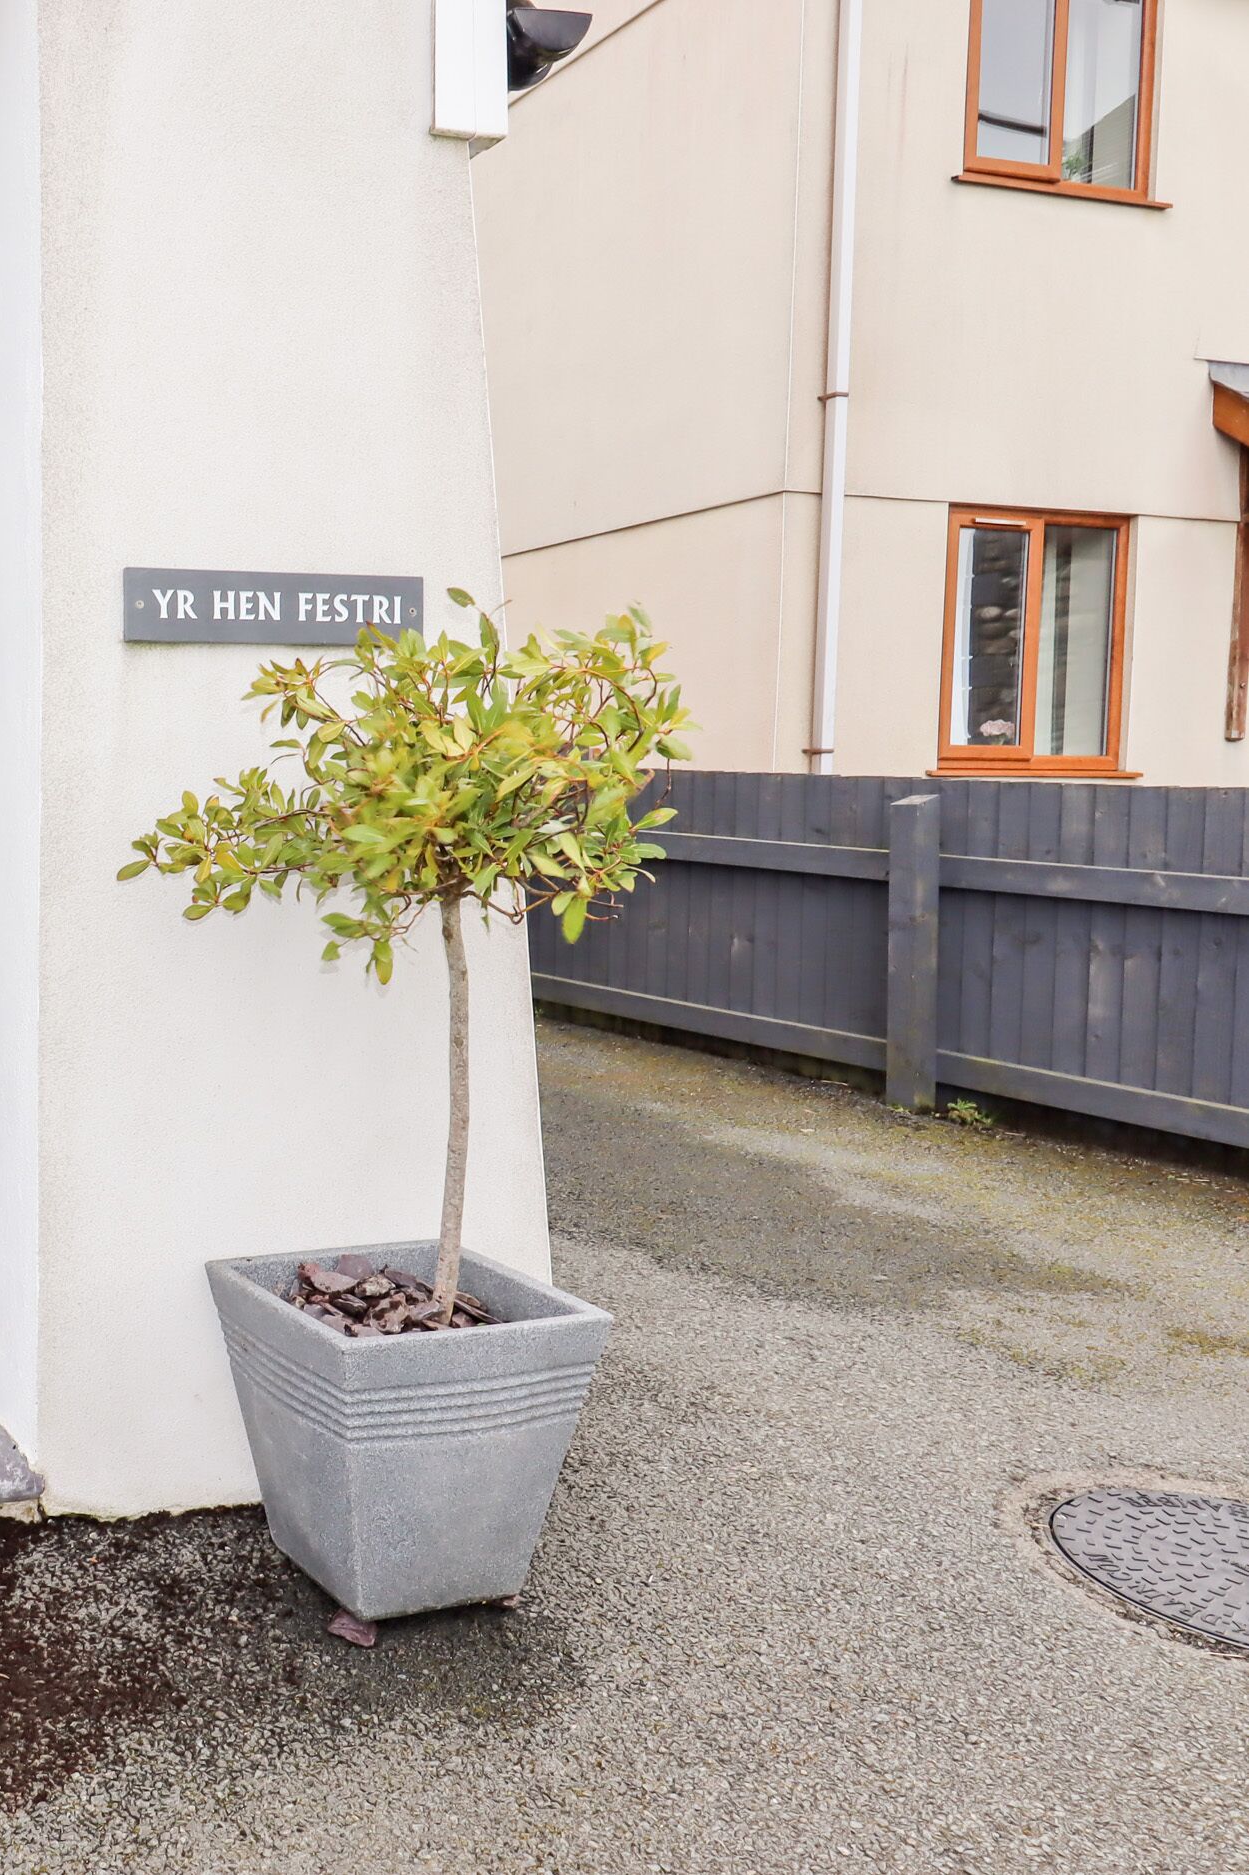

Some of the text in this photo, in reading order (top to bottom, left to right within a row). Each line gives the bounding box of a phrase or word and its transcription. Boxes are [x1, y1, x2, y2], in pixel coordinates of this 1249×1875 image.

[151, 588, 402, 625] YR HEN FESTRI
